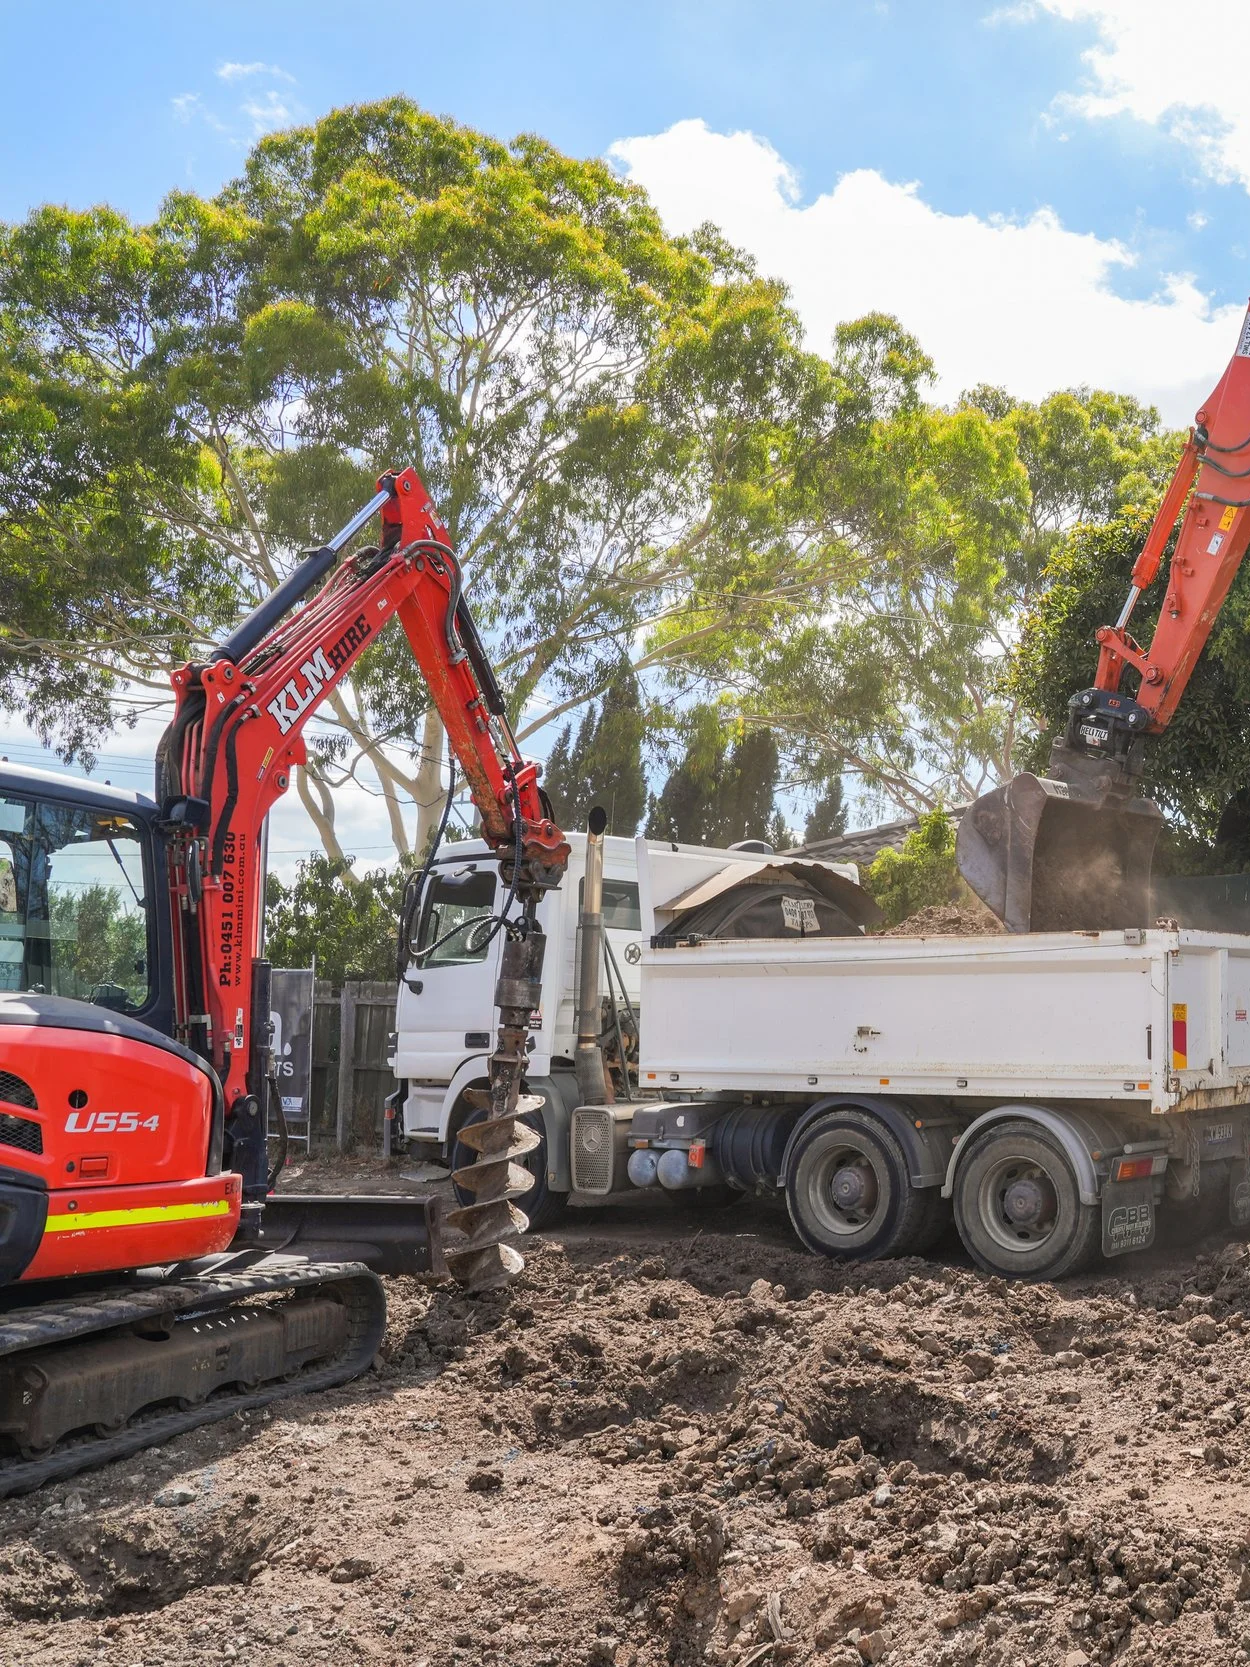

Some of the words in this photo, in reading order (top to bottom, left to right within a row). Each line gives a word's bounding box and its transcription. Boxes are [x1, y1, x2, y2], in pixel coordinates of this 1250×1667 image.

[266, 645, 336, 736] KLM
[328, 613, 372, 671] HIRE
[224, 831, 236, 864] 630
[223, 870, 235, 903] 007
[235, 833, 246, 987] www.klmmini.com.au
[220, 912, 234, 987] Ph:0451
[275, 1061, 294, 1077] TS
